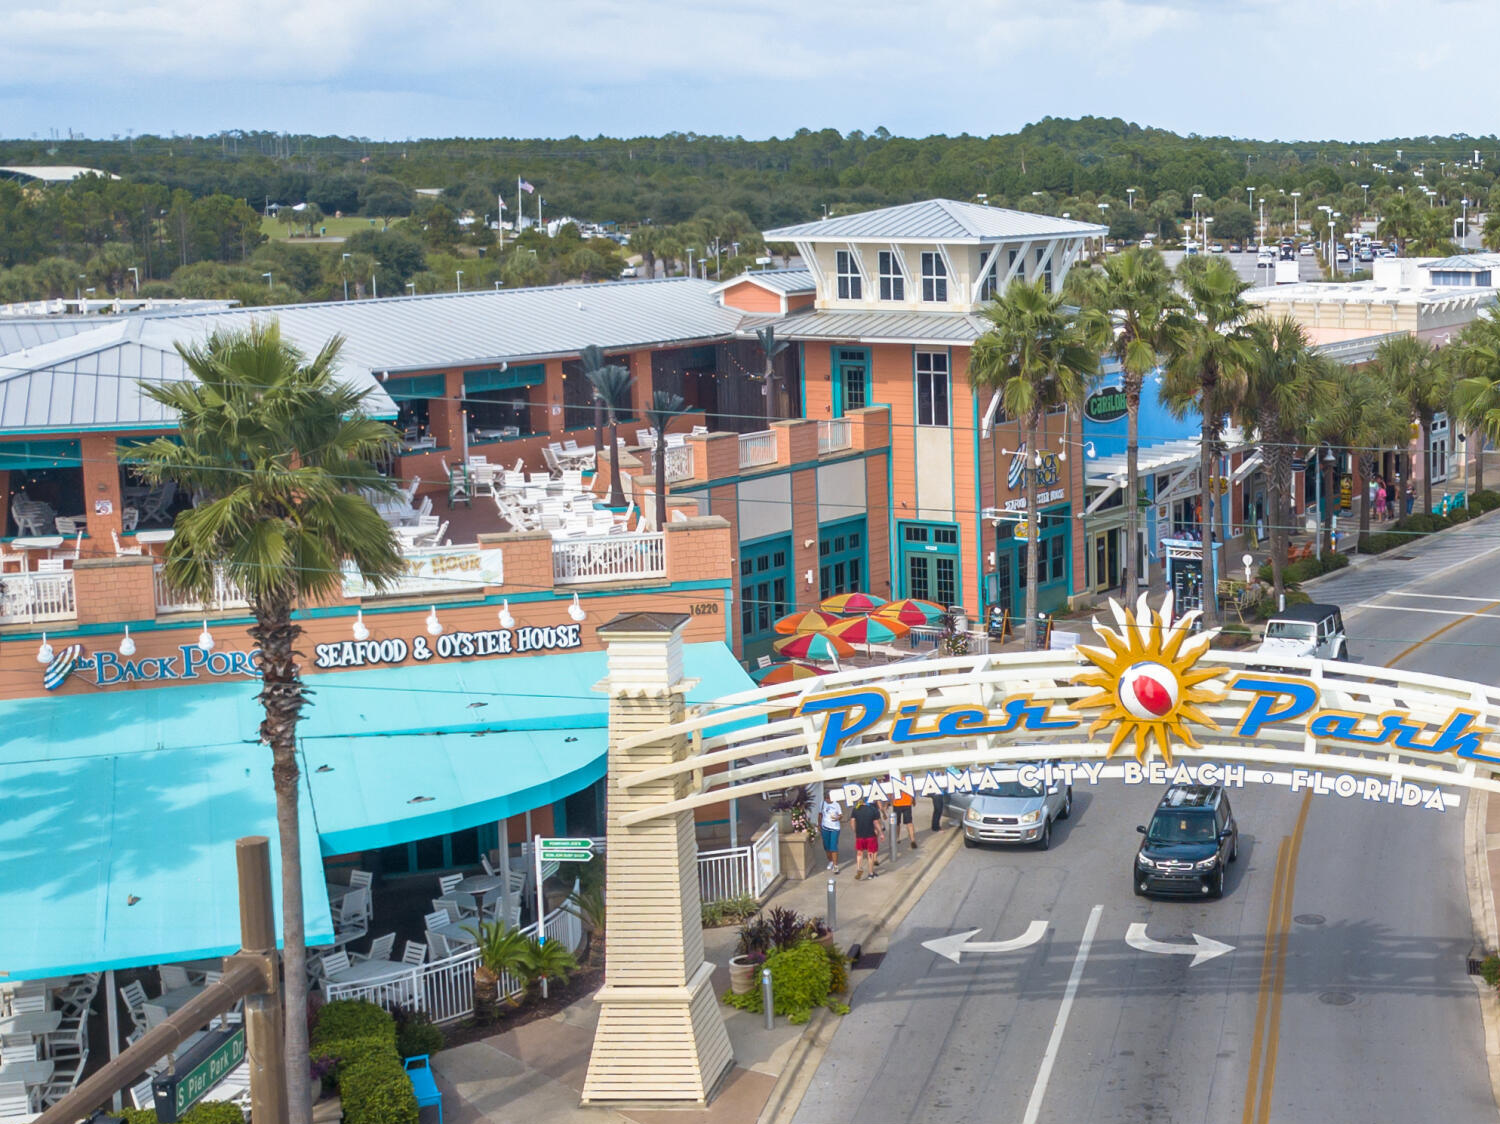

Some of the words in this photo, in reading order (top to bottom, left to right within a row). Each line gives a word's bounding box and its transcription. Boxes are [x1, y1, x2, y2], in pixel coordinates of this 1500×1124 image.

[690, 603, 719, 616] 16220
[92, 651, 178, 686] BACK
[180, 642, 264, 678] PORC
[315, 637, 409, 669] SEAFOOD
[412, 636, 433, 660] &
[436, 629, 513, 659] OYSTER
[515, 623, 581, 652] HOUSE
[794, 686, 1083, 760] Pier
[843, 766, 1001, 807] PANAMA
[1017, 761, 1106, 794] CITY
[1123, 761, 1246, 789] BEACH
[1290, 768, 1446, 813] FLORIDA
[178, 1086, 185, 1107] S
[188, 1072, 207, 1098] Pier
[209, 1050, 229, 1080] Park
[232, 1039, 243, 1060] Dr
